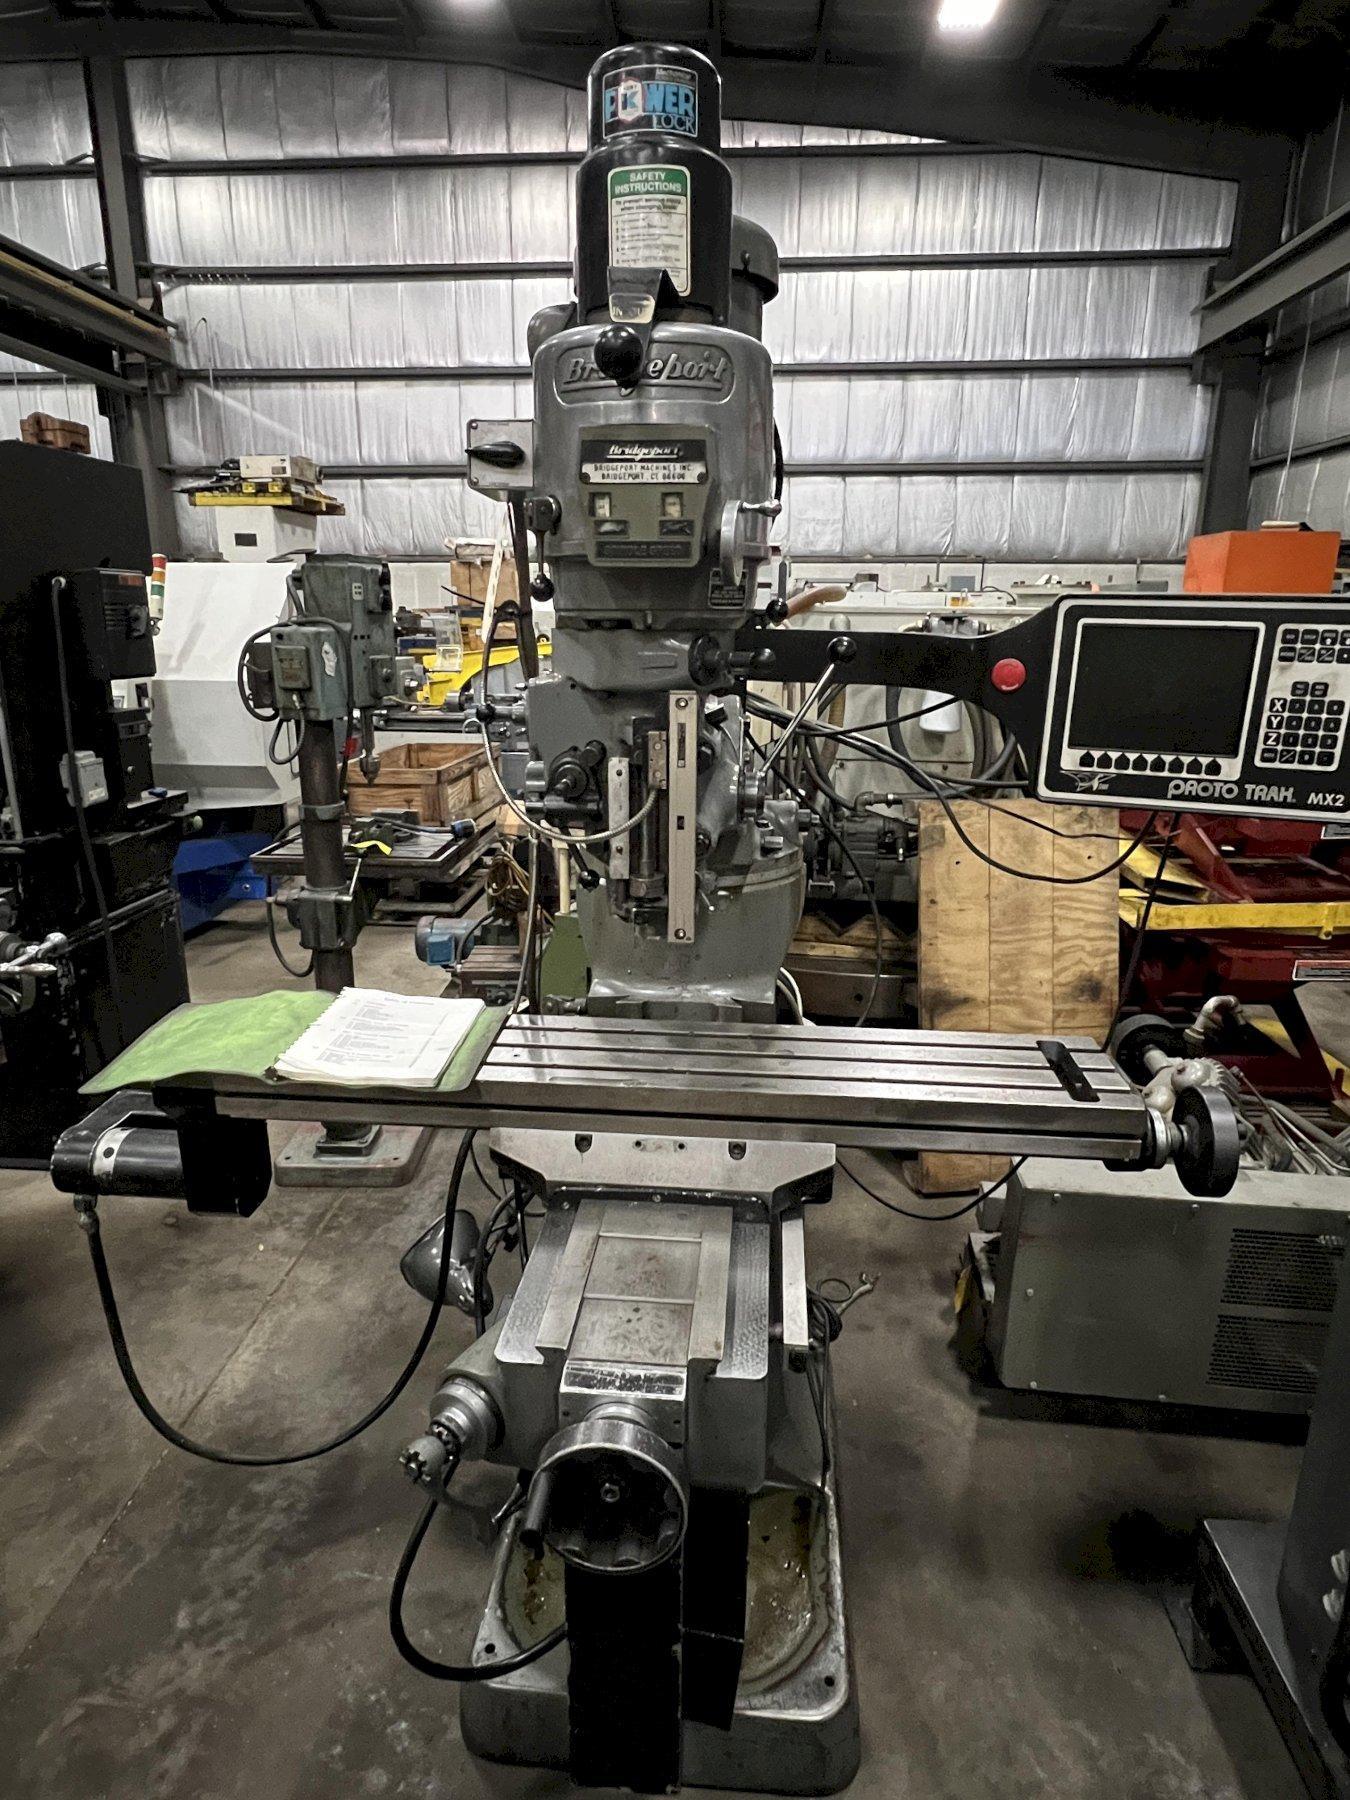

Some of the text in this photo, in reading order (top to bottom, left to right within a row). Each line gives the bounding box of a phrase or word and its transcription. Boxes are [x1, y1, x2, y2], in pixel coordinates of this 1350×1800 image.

[652, 114, 695, 134] LOCK
[629, 171, 666, 182] SAFETY
[614, 181, 682, 194] INSTRUCTIONS
[593, 464, 638, 472] BRIDGEPORT
[640, 464, 677, 472] MACHINES
[1272, 699, 1284, 712] X
[1270, 715, 1281, 728] Y
[1266, 732, 1279, 745] Z
[1167, 779, 1239, 799] PROTO
[1307, 792, 1345, 807] MX2
